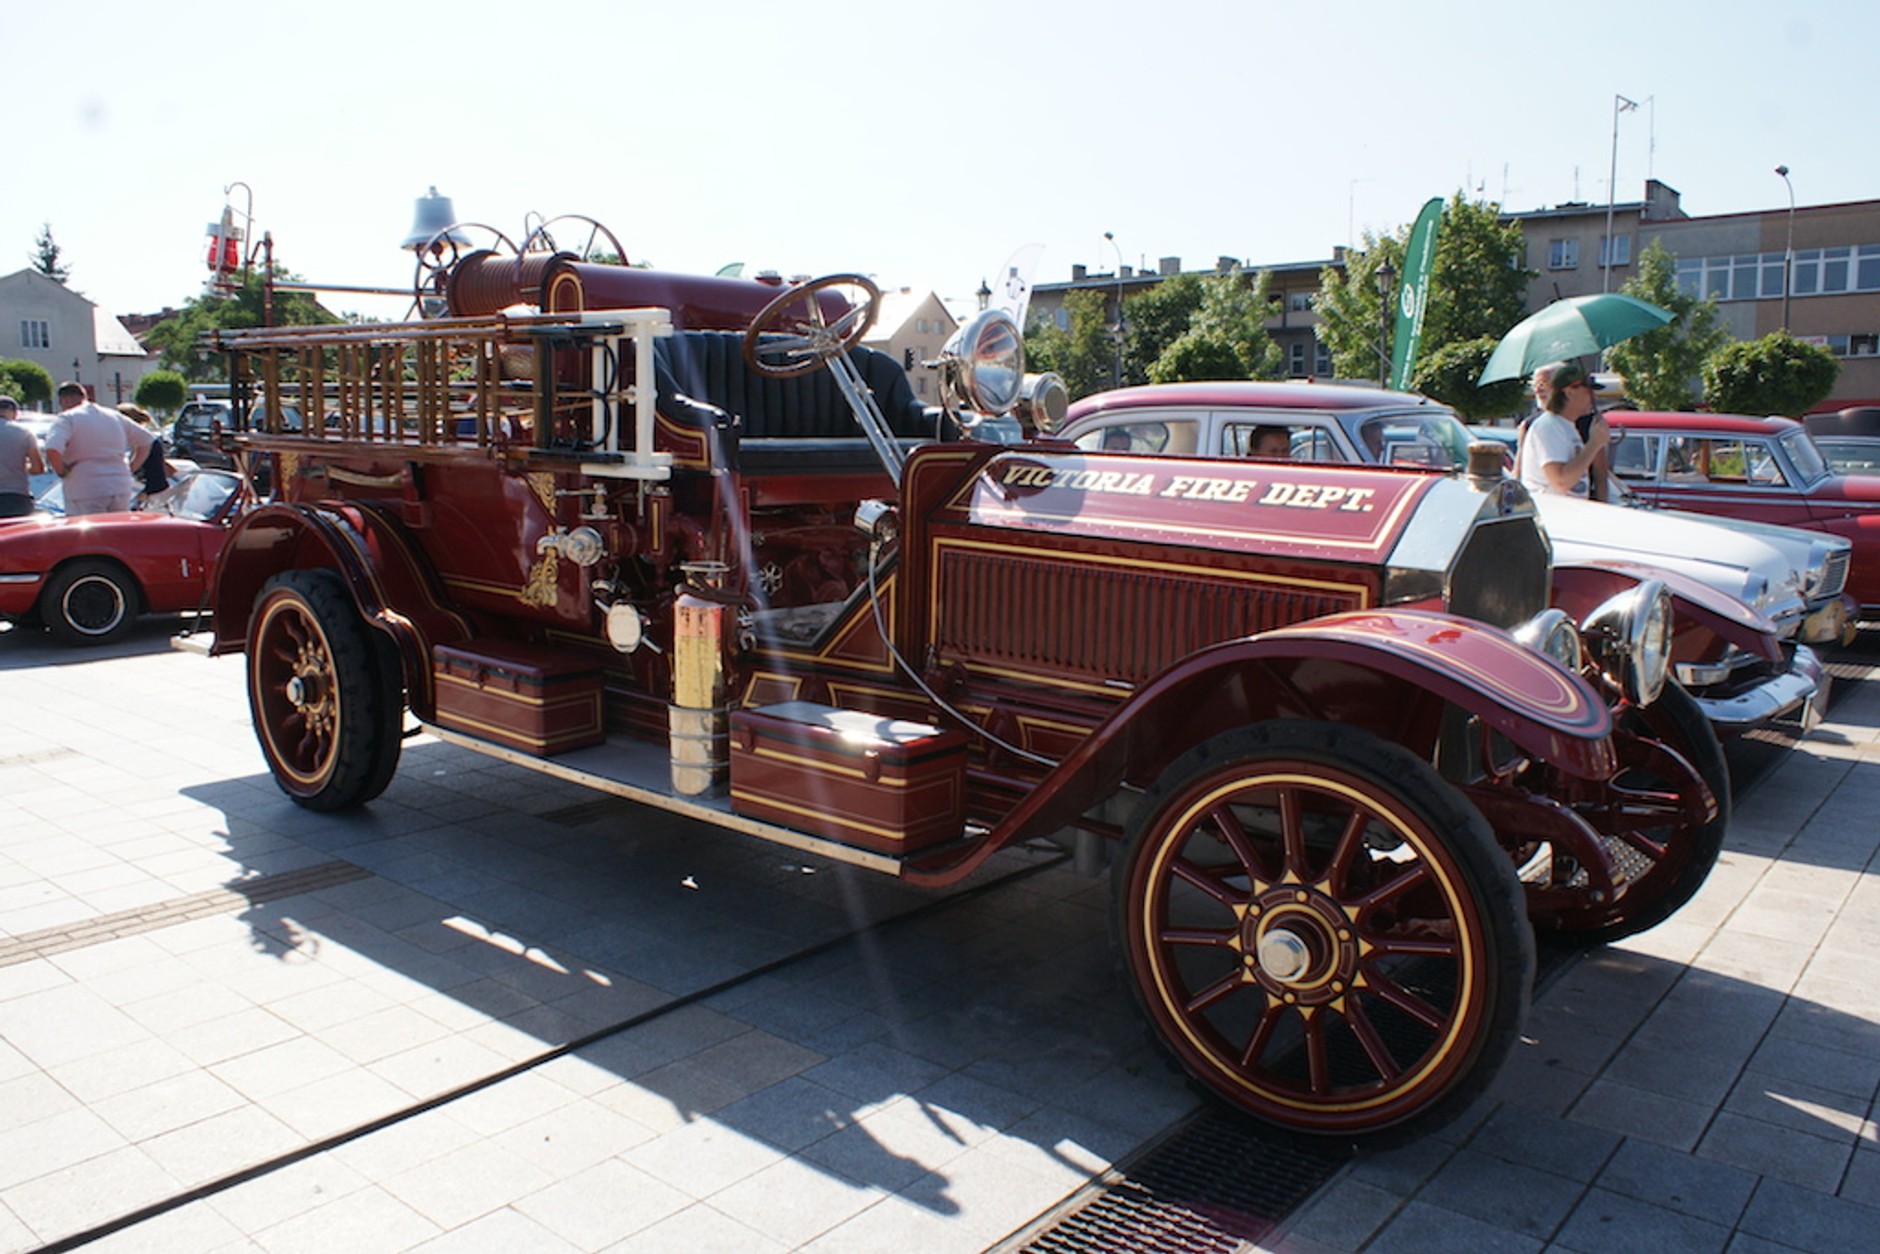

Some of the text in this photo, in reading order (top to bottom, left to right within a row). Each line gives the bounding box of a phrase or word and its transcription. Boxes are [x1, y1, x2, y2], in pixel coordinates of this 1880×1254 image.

[1002, 465, 1375, 512] VICTORIA FIRE DEPT.
